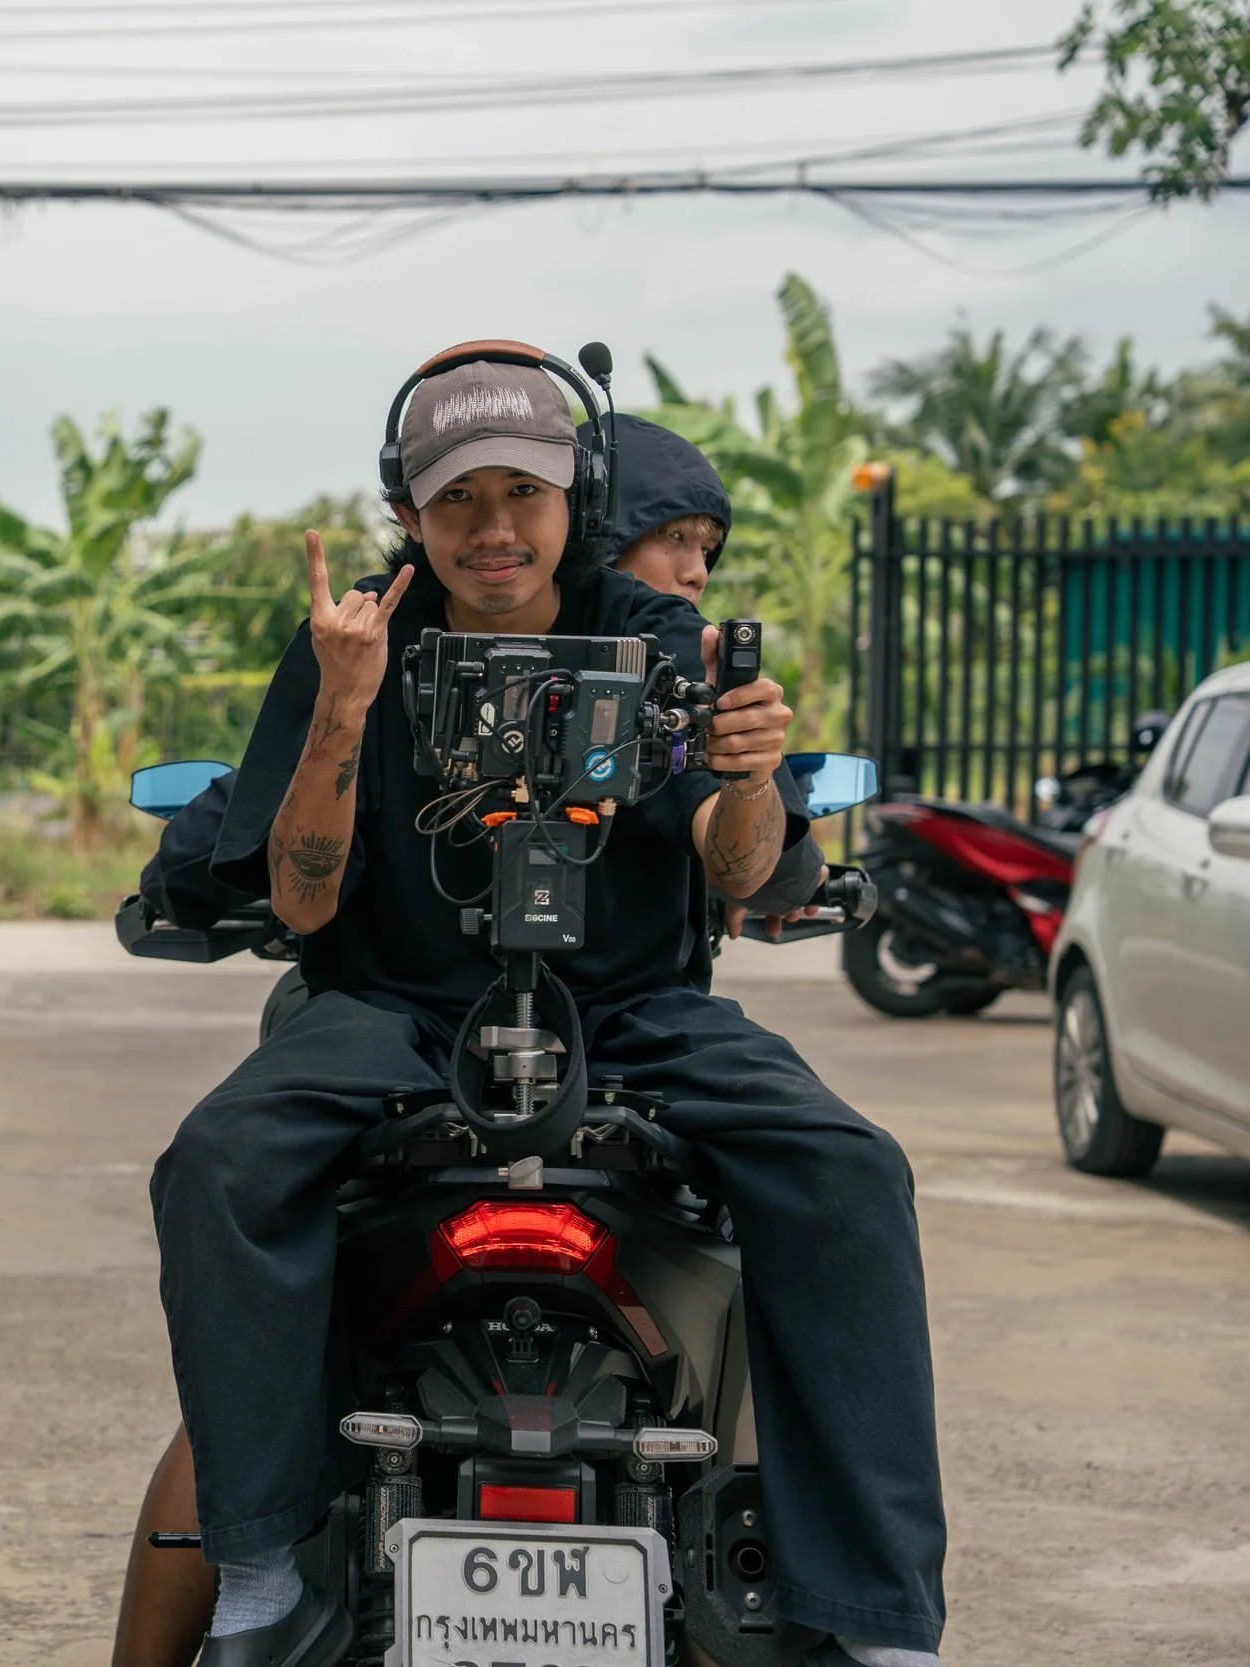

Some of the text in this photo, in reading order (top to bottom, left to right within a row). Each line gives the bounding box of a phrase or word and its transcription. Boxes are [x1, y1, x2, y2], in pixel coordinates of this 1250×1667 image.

[463, 1546, 590, 1598] 6ขฬ
[416, 1614, 637, 1650] กรุงเทพมหานคร
